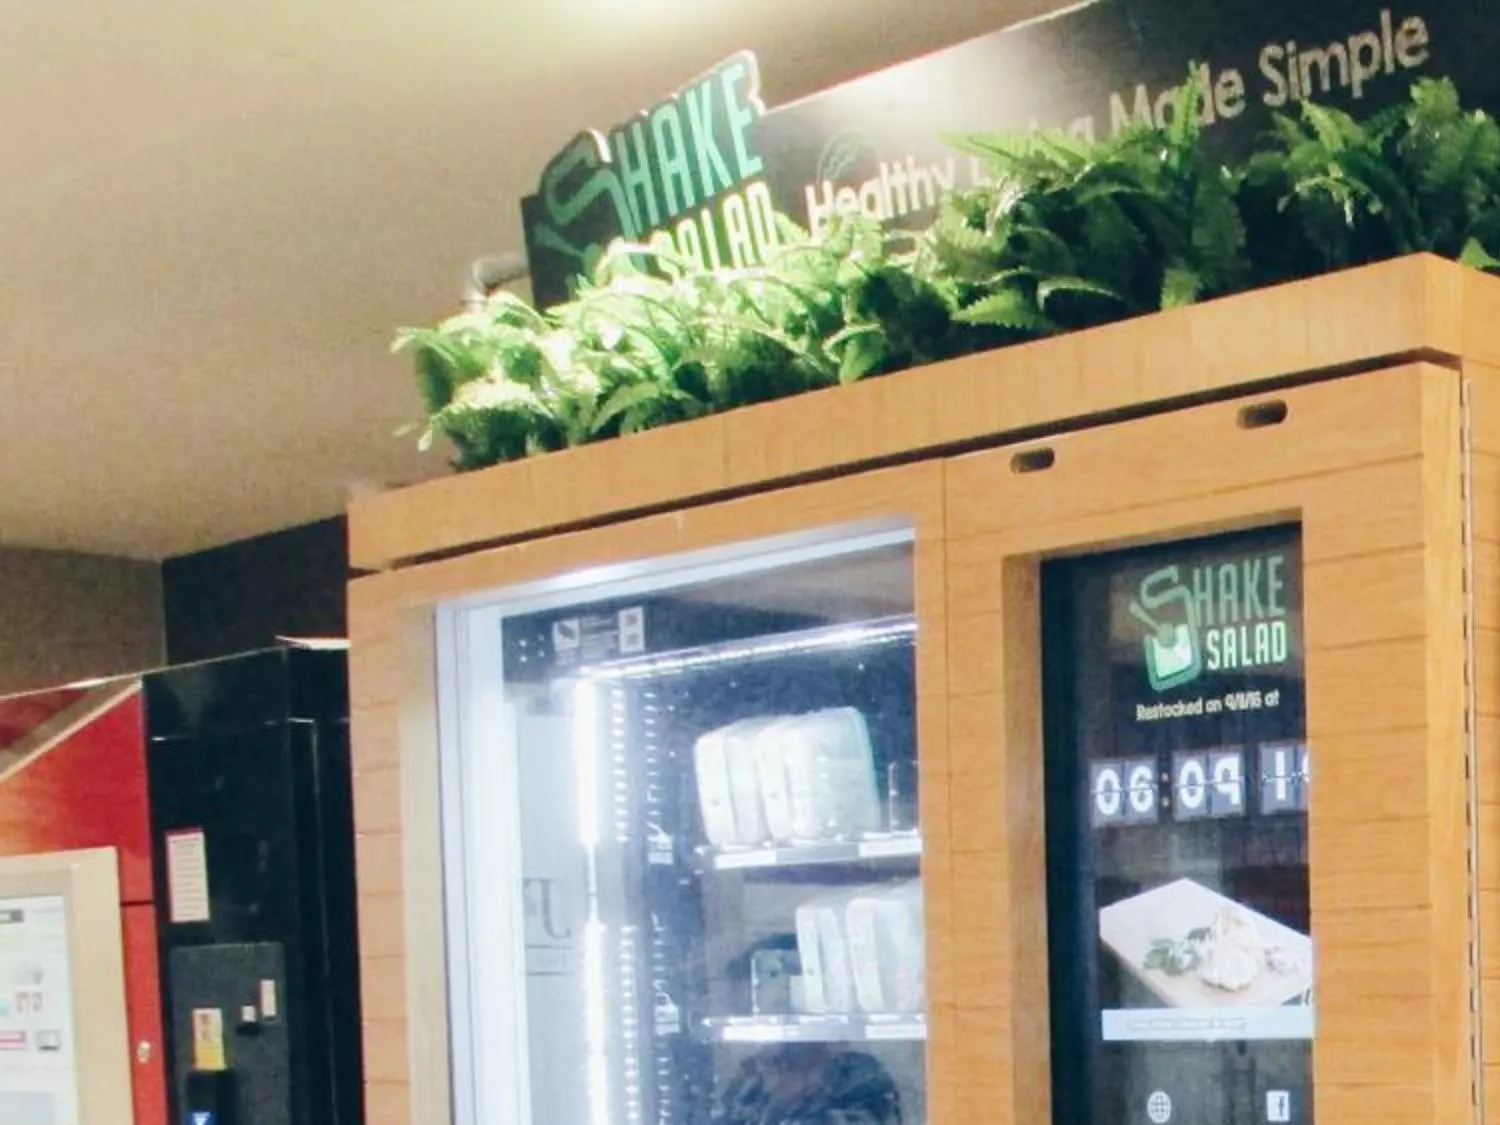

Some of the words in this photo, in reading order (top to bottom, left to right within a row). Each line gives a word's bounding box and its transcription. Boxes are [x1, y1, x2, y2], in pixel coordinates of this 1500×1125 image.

[1258, 9, 1430, 109] Simple
[541, 64, 764, 245] SHAKE
[1140, 555, 1286, 628] SHAKE
[1206, 621, 1287, 669] SALAD
